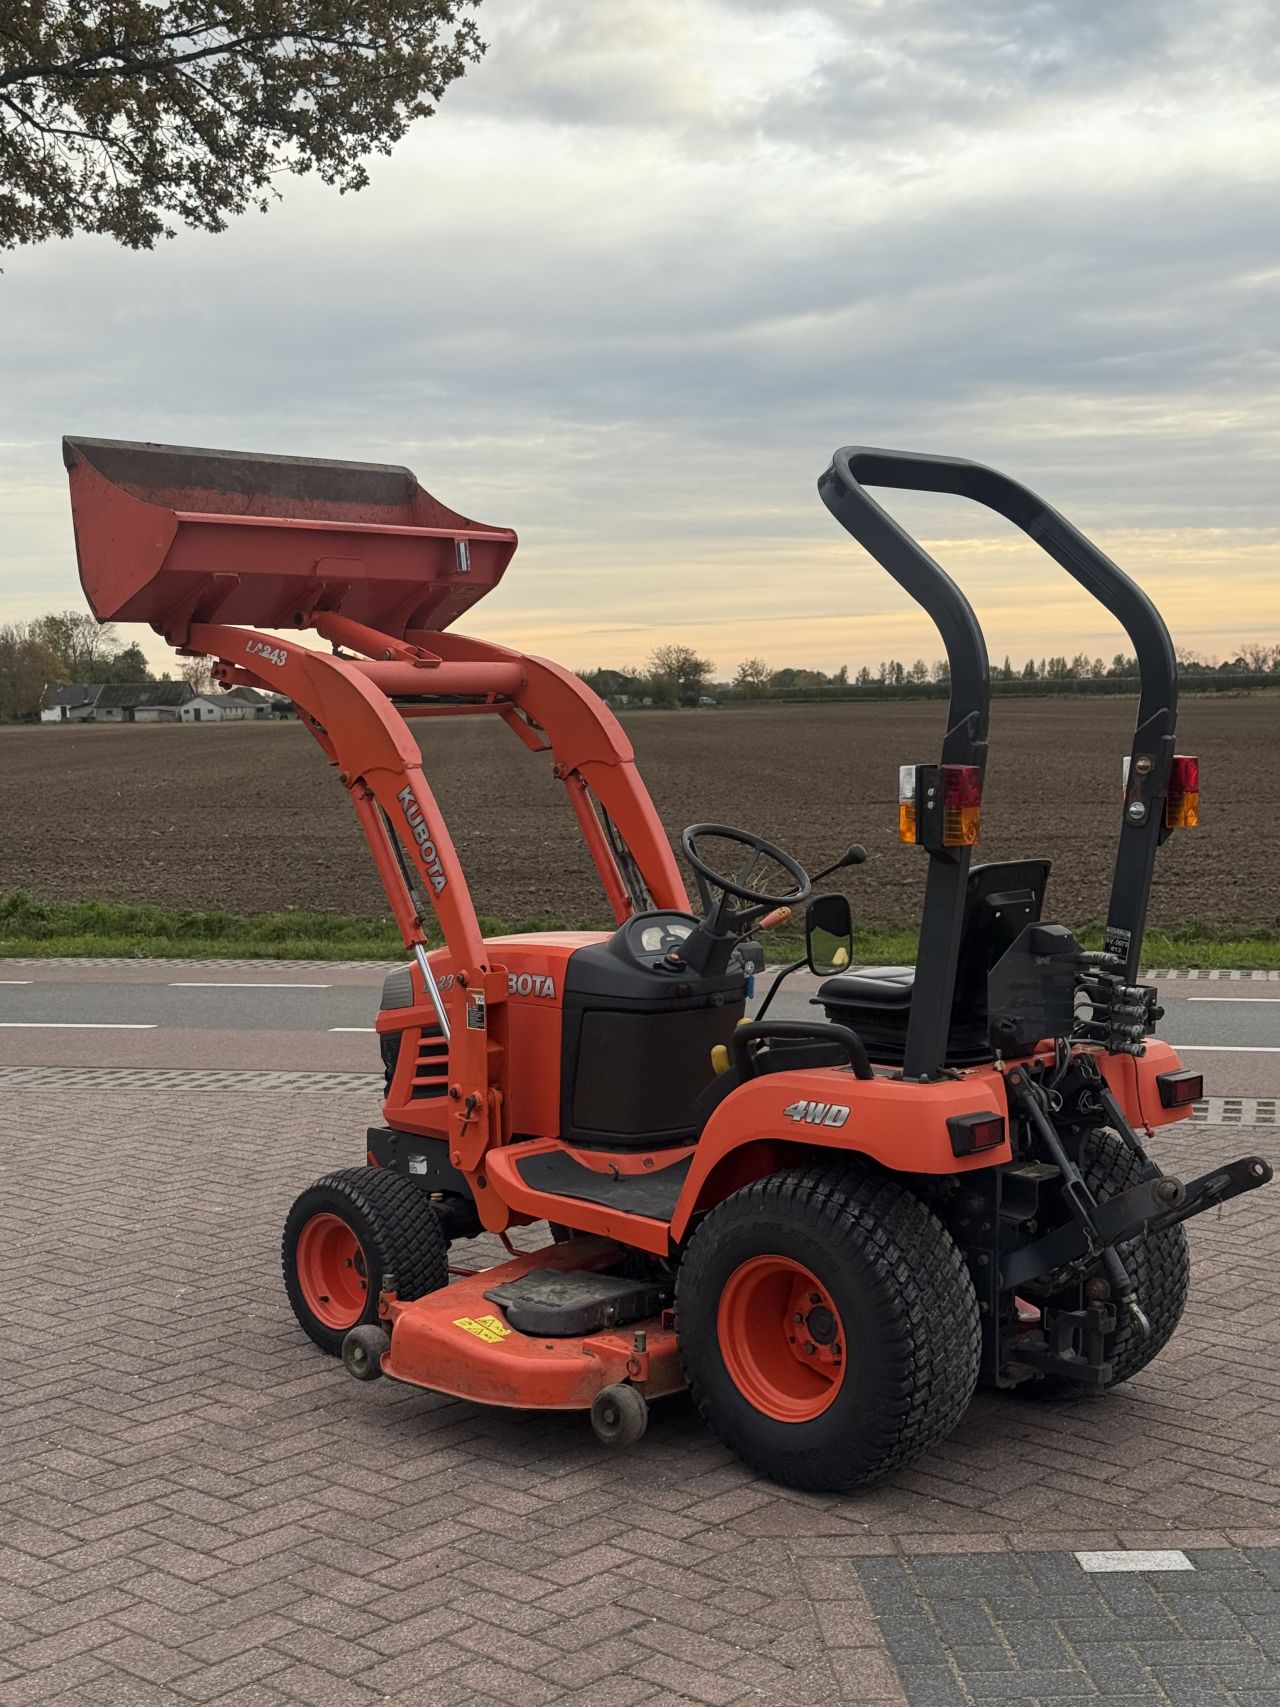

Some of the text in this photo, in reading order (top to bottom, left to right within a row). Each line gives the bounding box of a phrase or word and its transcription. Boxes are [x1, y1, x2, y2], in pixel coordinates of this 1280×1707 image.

[246, 640, 288, 666] LA243
[398, 785, 448, 896] KUBOTA
[507, 972, 557, 999] BOTA
[784, 1100, 852, 1128] 4WD
